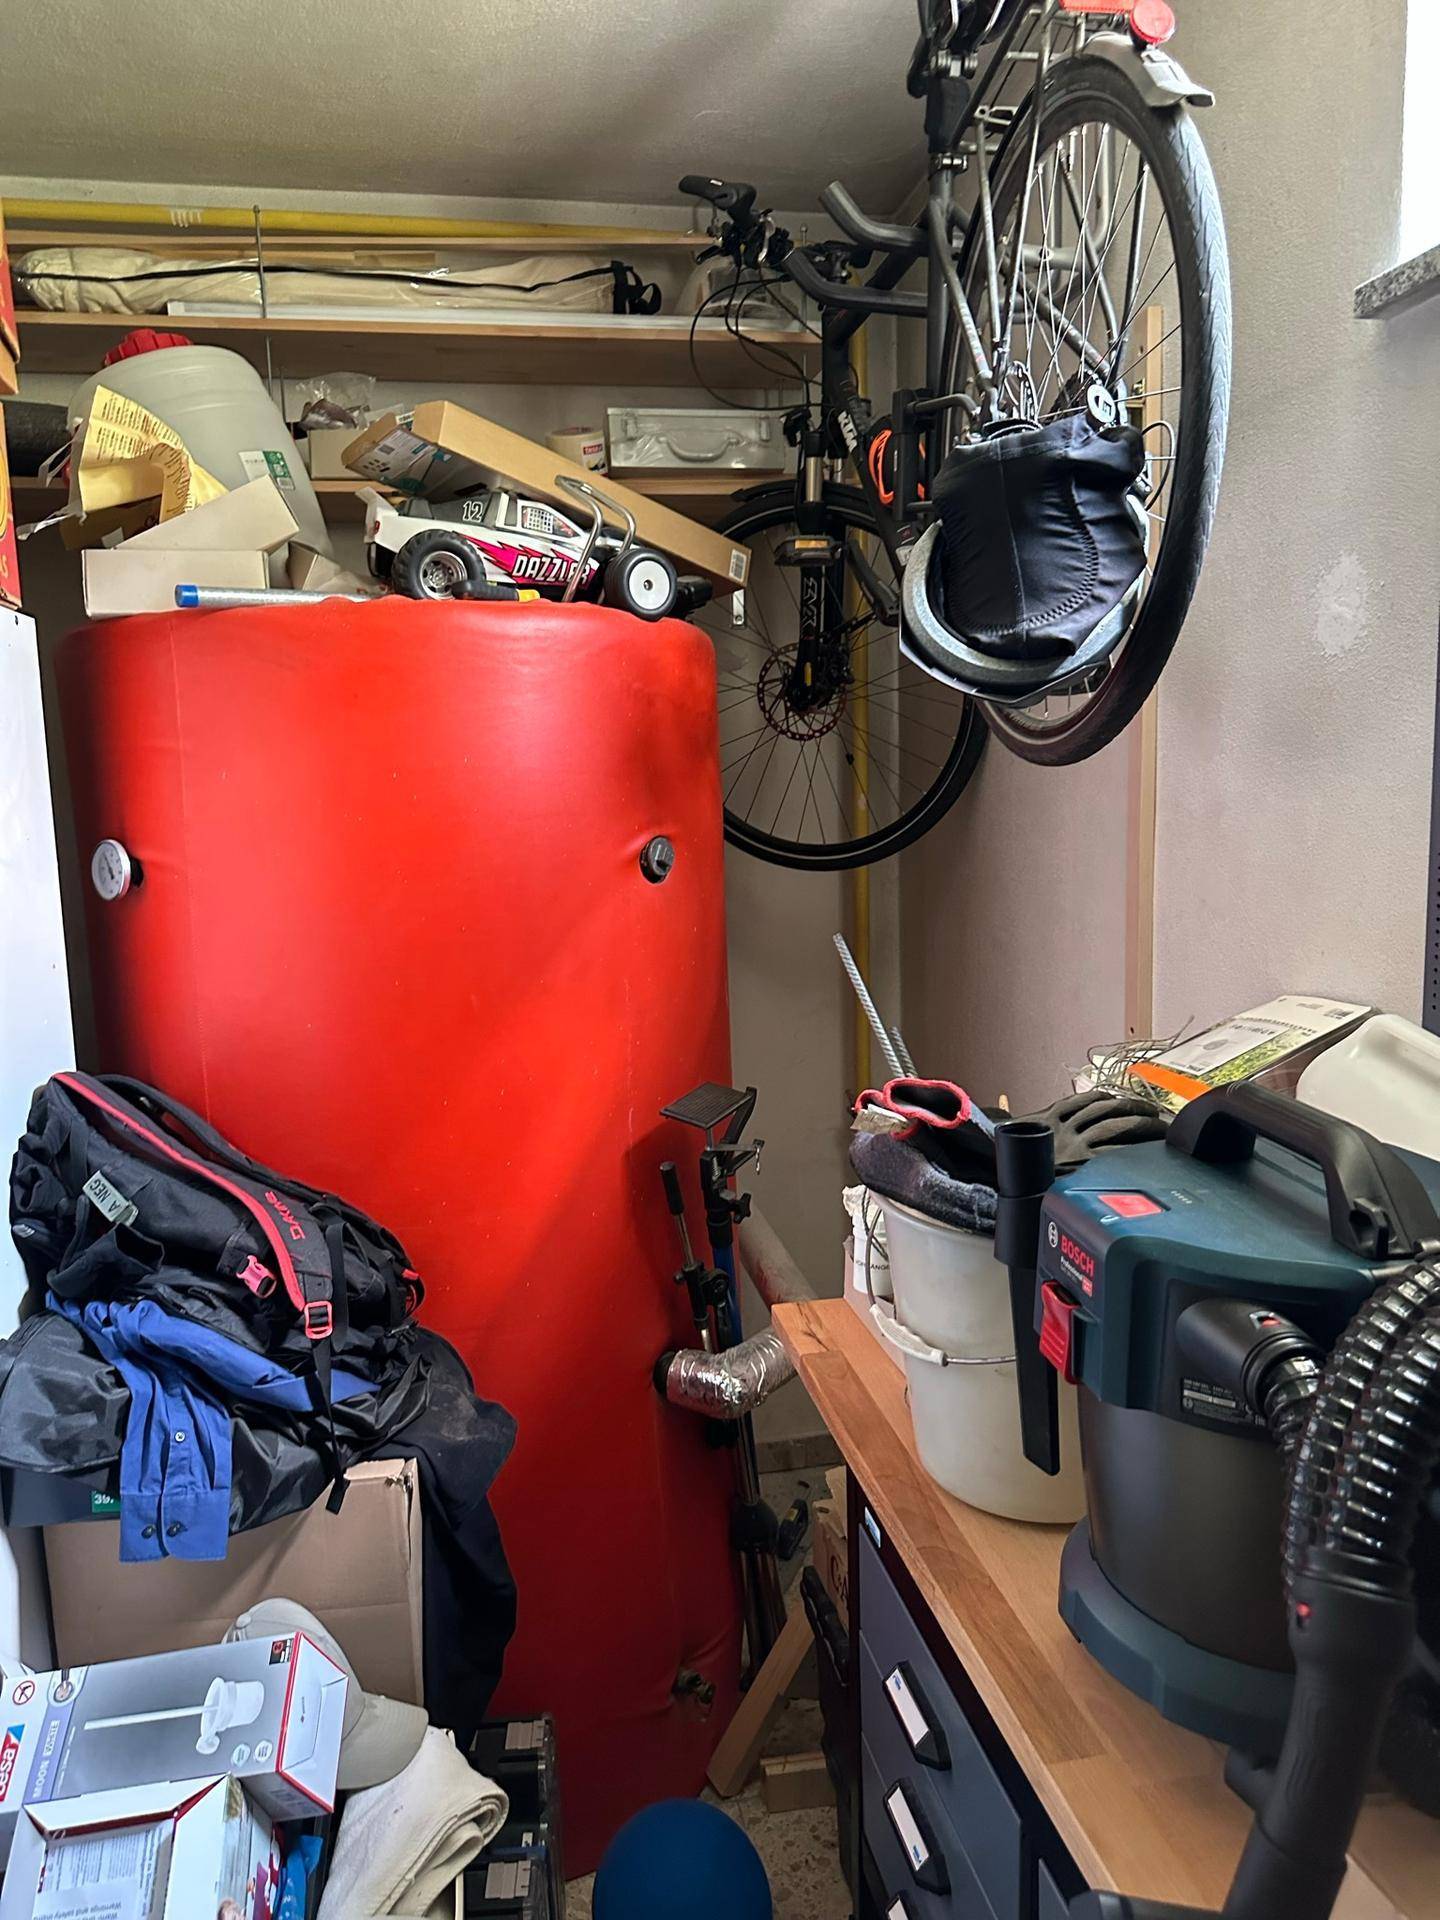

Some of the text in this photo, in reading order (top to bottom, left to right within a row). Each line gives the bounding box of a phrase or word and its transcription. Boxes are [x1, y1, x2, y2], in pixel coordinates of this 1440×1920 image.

[837, 410, 859, 453] KTM
[462, 501, 484, 523] 12
[90, 1178, 121, 1213] A NEG
[1061, 1233, 1096, 1278] BOSCH
